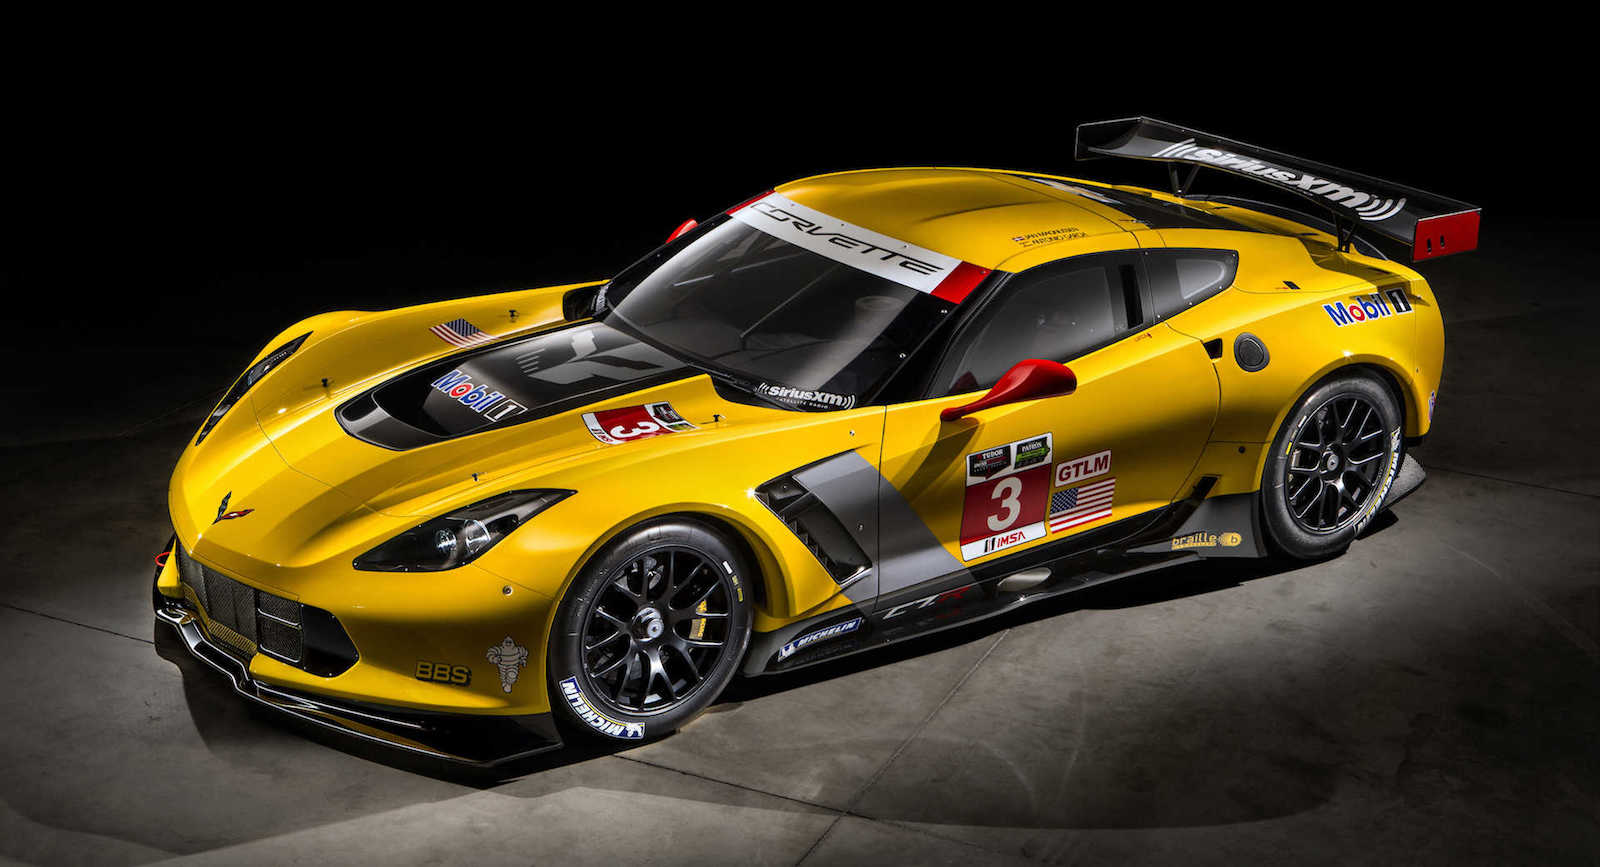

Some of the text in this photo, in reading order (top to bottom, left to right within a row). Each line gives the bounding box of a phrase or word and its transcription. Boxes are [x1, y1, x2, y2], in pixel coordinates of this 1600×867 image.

[750, 202, 945, 275] CORVETTE
[1321, 289, 1409, 328] Mobil 1
[431, 369, 522, 421] Mobil 1
[610, 421, 660, 438] 3
[1059, 455, 1109, 482] GTLM
[987, 476, 1023, 531] 3
[997, 531, 1026, 548] IMSA
[1172, 532, 1217, 546] braille
[798, 621, 857, 647] MICHELIN
[415, 661, 469, 683] BBS
[561, 681, 626, 737] MICHELIN
